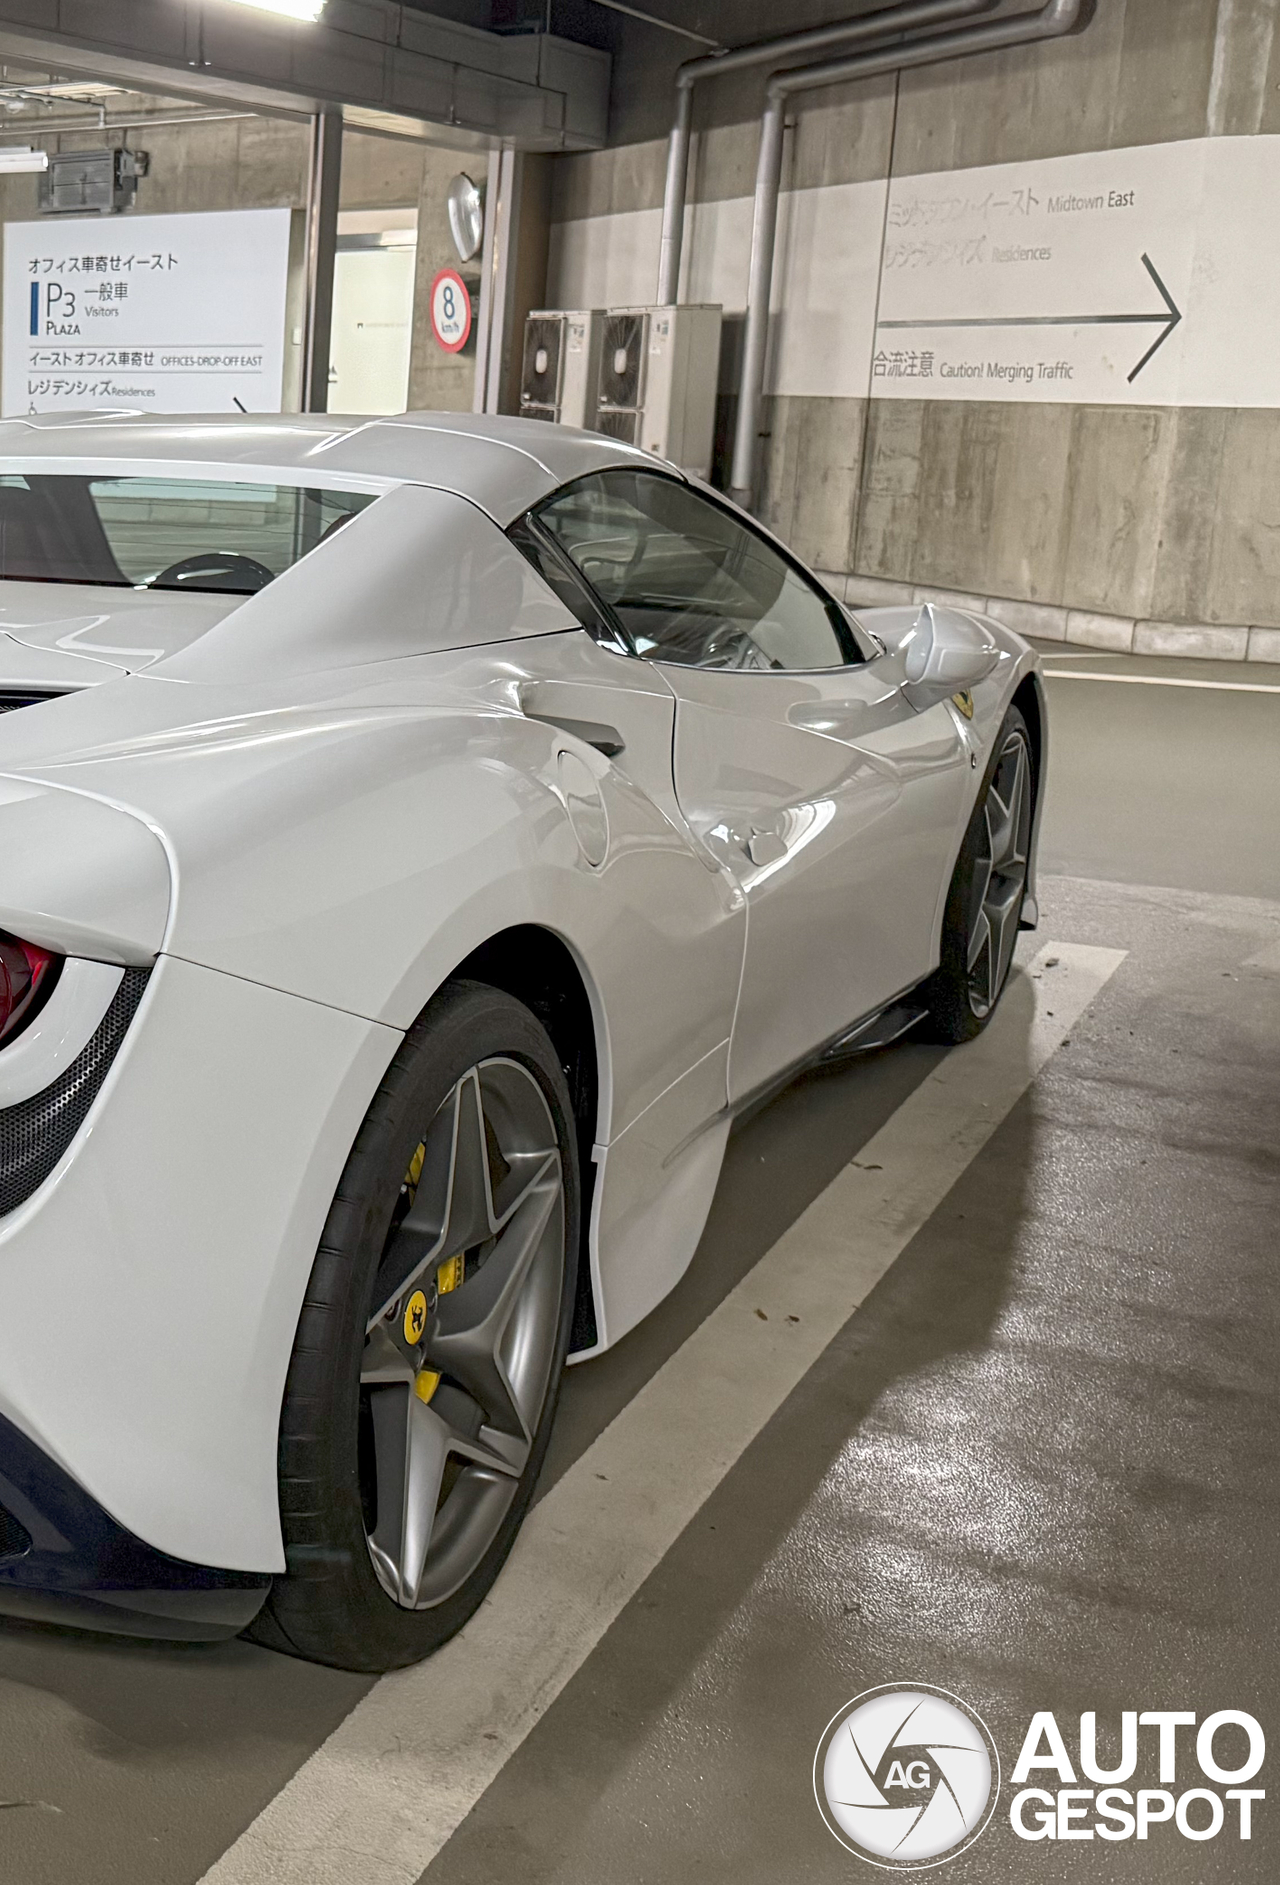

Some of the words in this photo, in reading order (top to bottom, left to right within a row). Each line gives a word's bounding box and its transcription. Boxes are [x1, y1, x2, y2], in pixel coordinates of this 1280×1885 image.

[1047, 195, 1104, 213] Midtown
[1107, 189, 1135, 208] East
[28, 253, 178, 274] オフィス車寄せイースト
[46, 283, 76, 318] P3
[84, 282, 129, 301] 一般車
[84, 307, 119, 318] Visitors
[443, 286, 455, 320] 8
[46, 321, 81, 336] PLAZA
[873, 351, 934, 378] 合流注意
[939, 362, 984, 379] Caution!
[986, 363, 1034, 383] Merging
[1037, 361, 1073, 379] Traffic
